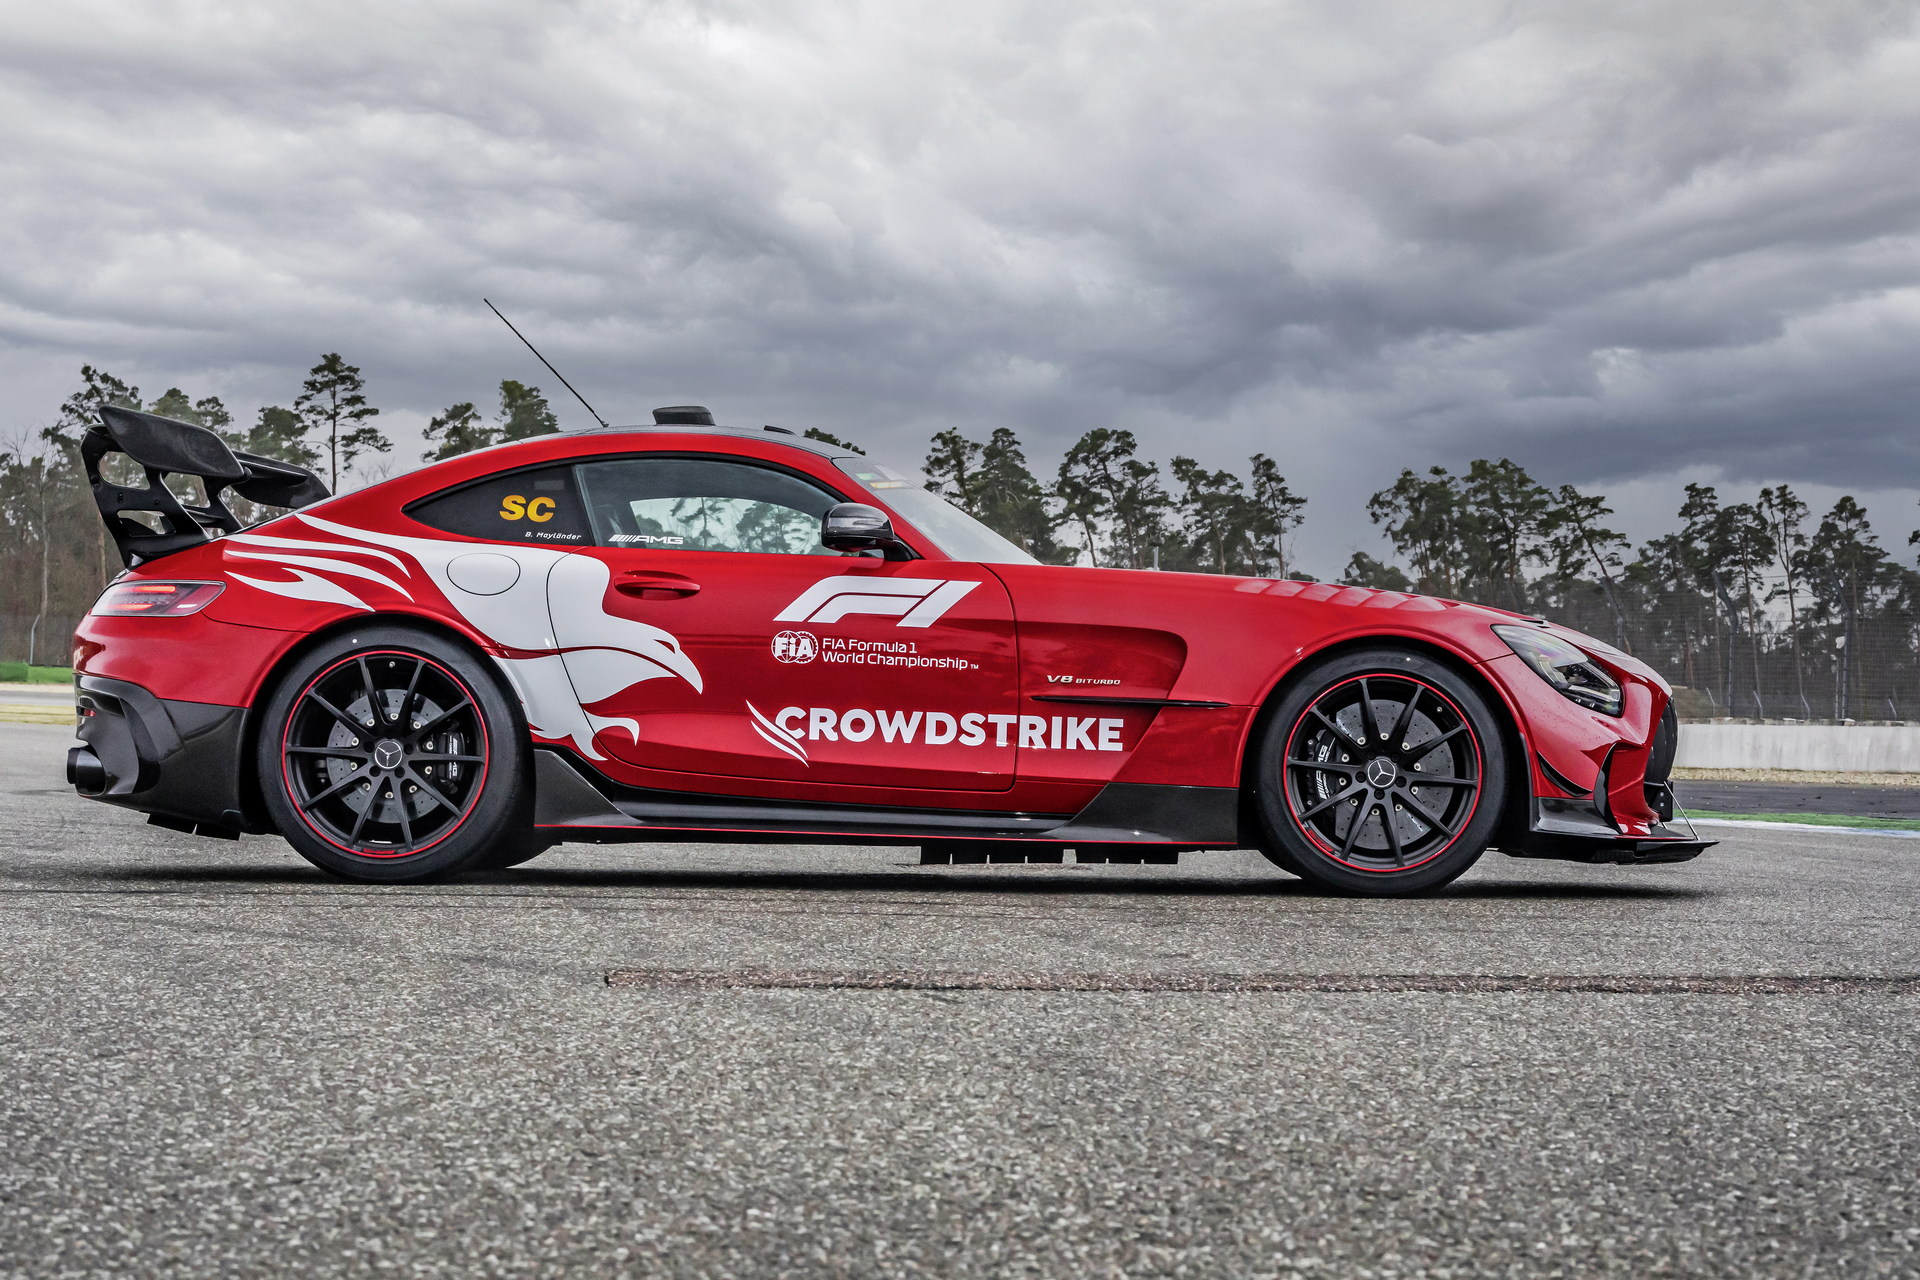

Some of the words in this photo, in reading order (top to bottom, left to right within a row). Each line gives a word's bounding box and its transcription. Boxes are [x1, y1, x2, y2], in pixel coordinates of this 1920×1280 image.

[499, 494, 556, 523] SC
[536, 532, 582, 540] Mayländer
[773, 576, 983, 628] F1
[822, 638, 846, 650] FIA
[848, 639, 907, 653] Formula
[909, 642, 918, 654] 1
[821, 651, 865, 664] World
[867, 653, 968, 671] Championship
[1047, 675, 1073, 683] V8
[774, 706, 1125, 752] CROWDSTRIKE
